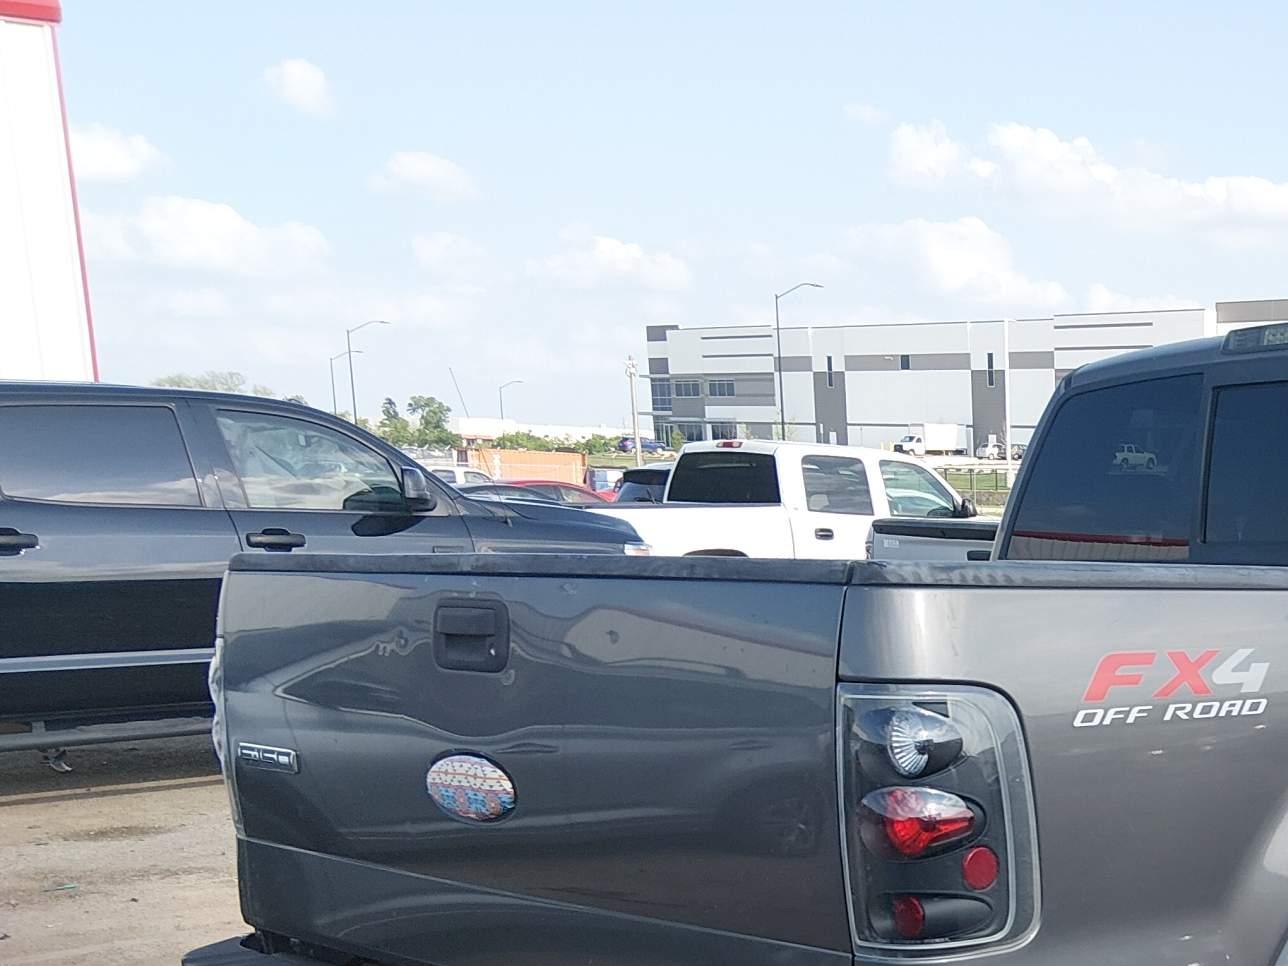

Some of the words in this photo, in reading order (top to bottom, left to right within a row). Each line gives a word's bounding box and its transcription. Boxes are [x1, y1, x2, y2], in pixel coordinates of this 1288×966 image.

[1081, 648, 1270, 703] FX4
[1072, 705, 1153, 729] OFF
[1163, 698, 1269, 722] ROAD
